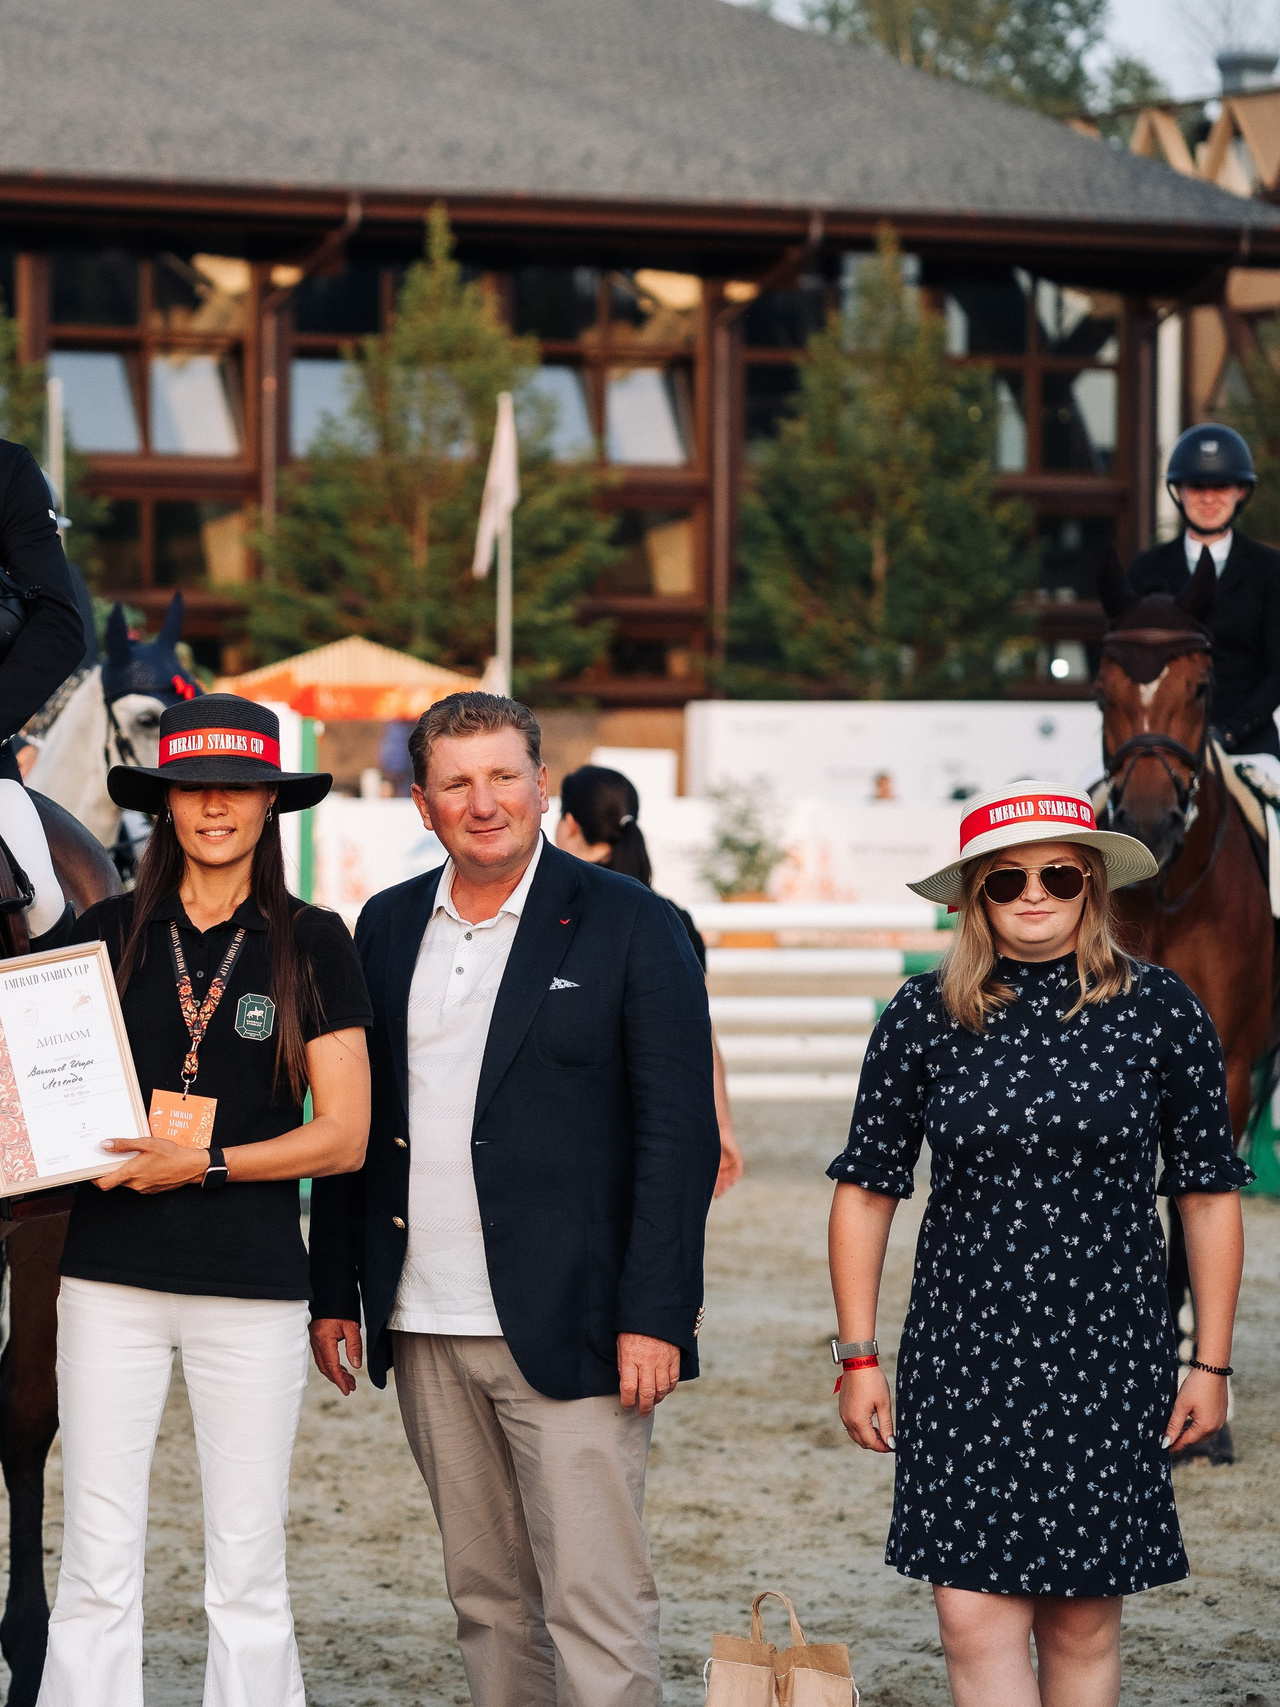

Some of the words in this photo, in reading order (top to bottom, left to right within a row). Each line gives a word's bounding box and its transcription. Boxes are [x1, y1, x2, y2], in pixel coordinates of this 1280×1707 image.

[169, 736, 204, 756] EMERALD
[207, 734, 247, 752] STABLES
[251, 737, 264, 755] CUP
[989, 801, 1034, 825] EMERALD
[1038, 800, 1079, 819] STABLES
[1080, 805, 1091, 823] CUP
[234, 927, 246, 943] RALD
[4, 973, 39, 991] EMERALD
[41, 967, 73, 983] STABLES
[74, 963, 90, 976] CUP
[36, 1028, 91, 1049] ДИПЛОМ
[170, 1109, 193, 1120] EMERALD
[167, 1128, 178, 1136] CUP
[169, 1119, 189, 1129] STABLES
